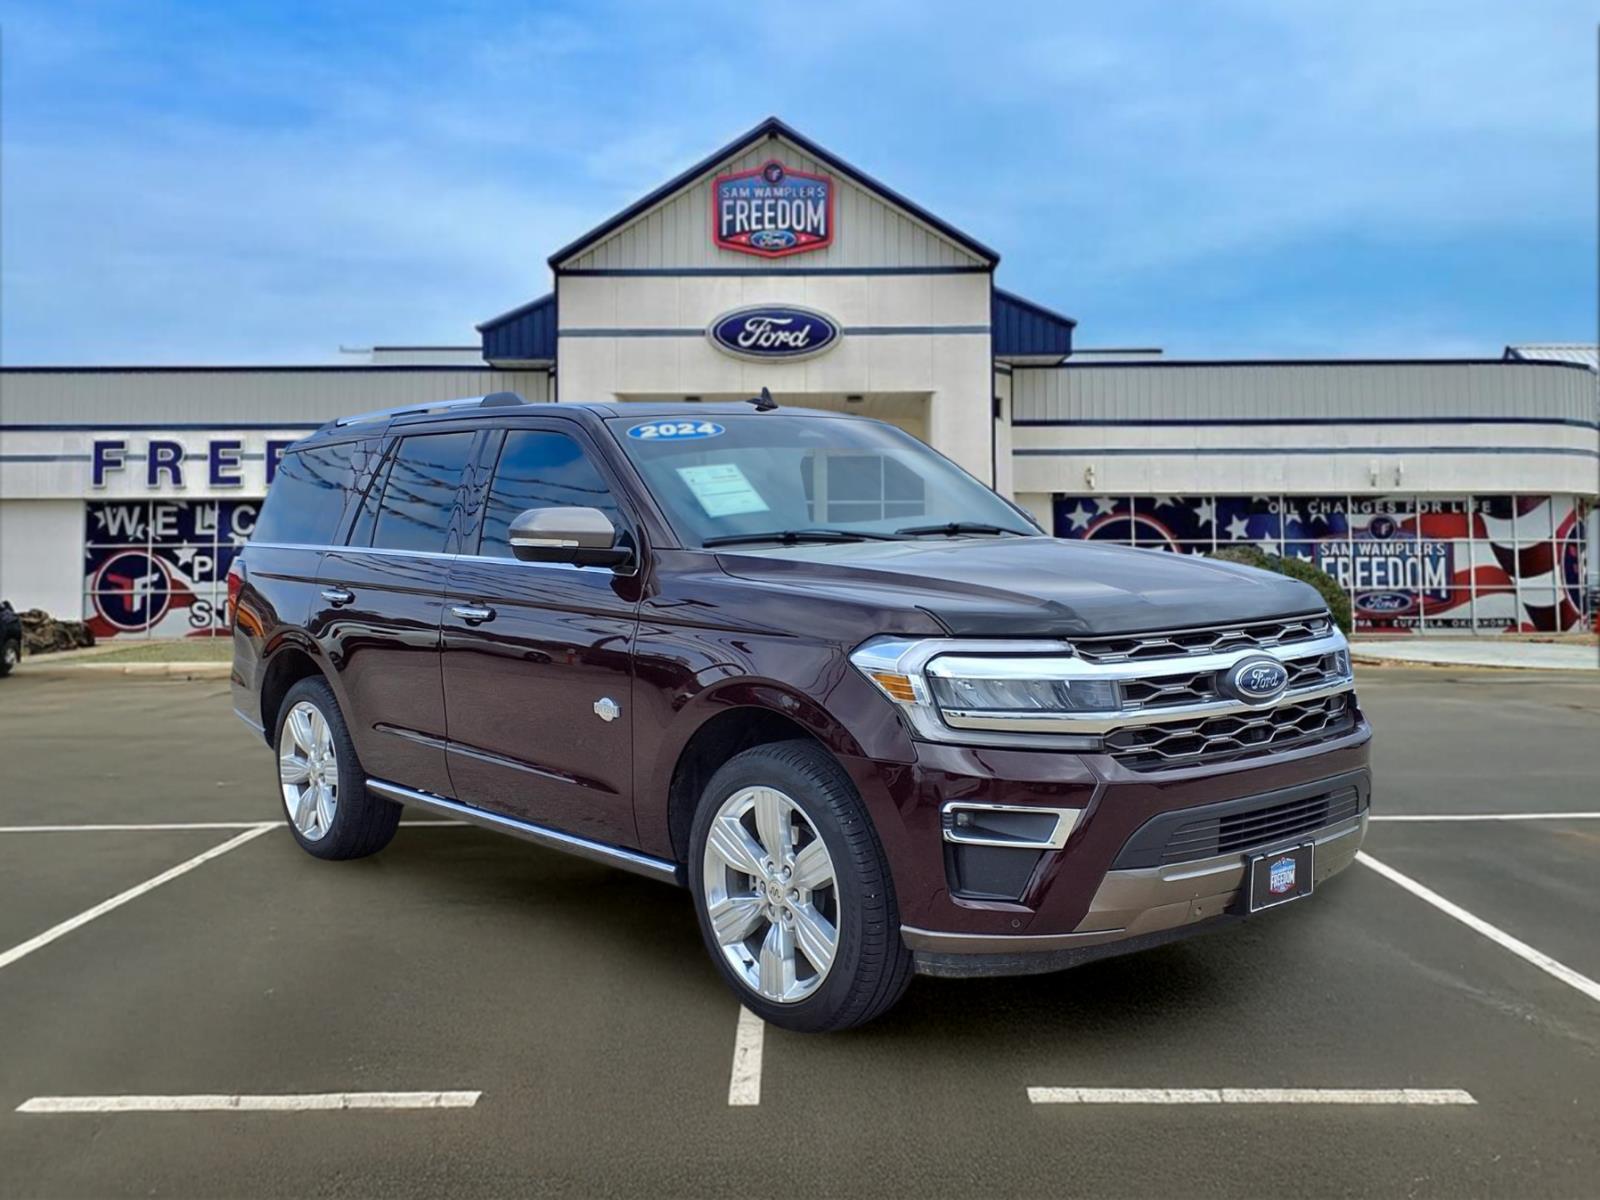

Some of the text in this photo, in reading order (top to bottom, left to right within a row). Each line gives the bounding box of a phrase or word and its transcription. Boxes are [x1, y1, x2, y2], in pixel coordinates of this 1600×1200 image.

[722, 187, 750, 198] SAM
[721, 199, 826, 236] FREEDOM
[737, 316, 811, 348] Ford
[638, 422, 717, 439] 2024
[1267, 499, 1491, 514] OIL CHANGES FOR LIFE
[1320, 556, 1448, 599] FREEDOM
[1365, 594, 1400, 609] Ford
[1250, 668, 1279, 690] Ford
